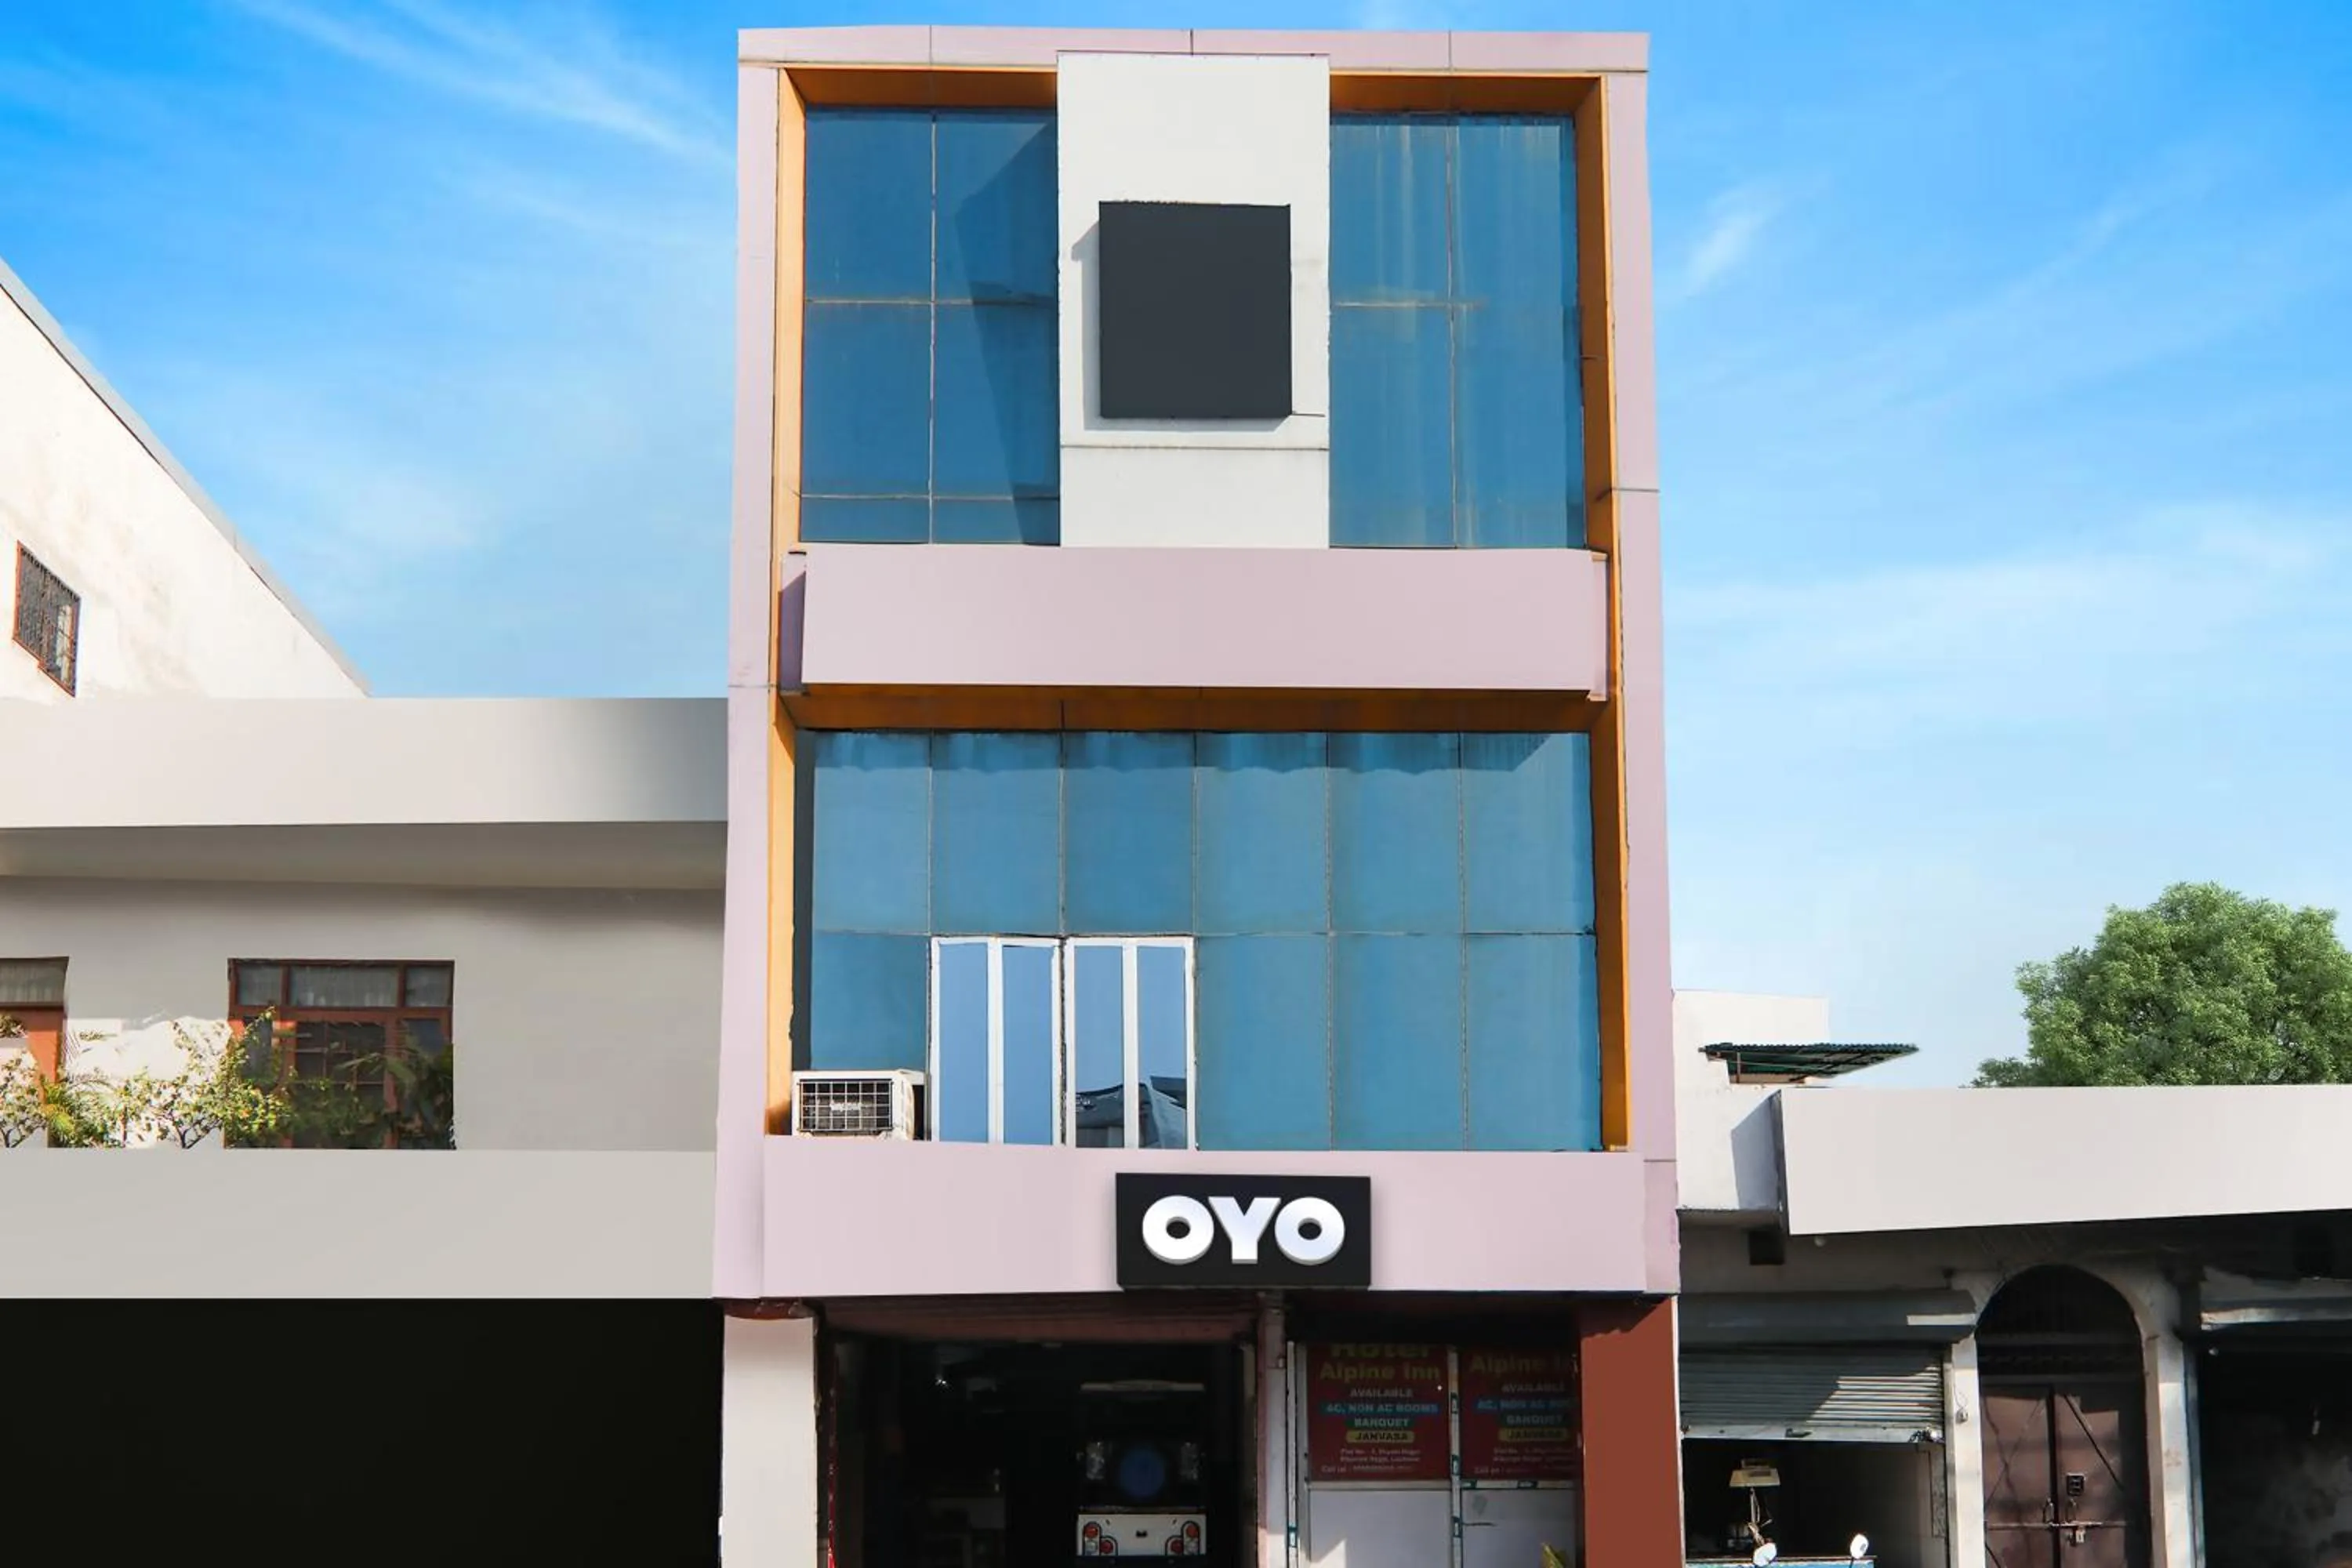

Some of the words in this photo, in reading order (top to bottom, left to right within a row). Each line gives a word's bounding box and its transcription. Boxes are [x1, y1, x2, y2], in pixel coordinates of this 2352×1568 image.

[1142, 1194, 1345, 1265] OYO
[1321, 1361, 1395, 1383] Alpine
[1403, 1362, 1440, 1379] Inn
[1469, 1355, 1545, 1377] Alpine
[1349, 1387, 1414, 1398] AVAILABLE
[1348, 1403, 1374, 1413] NON
[1377, 1403, 1393, 1413] AC
[1396, 1403, 1439, 1413] ROOMS
[1354, 1417, 1410, 1428] BANQUET
